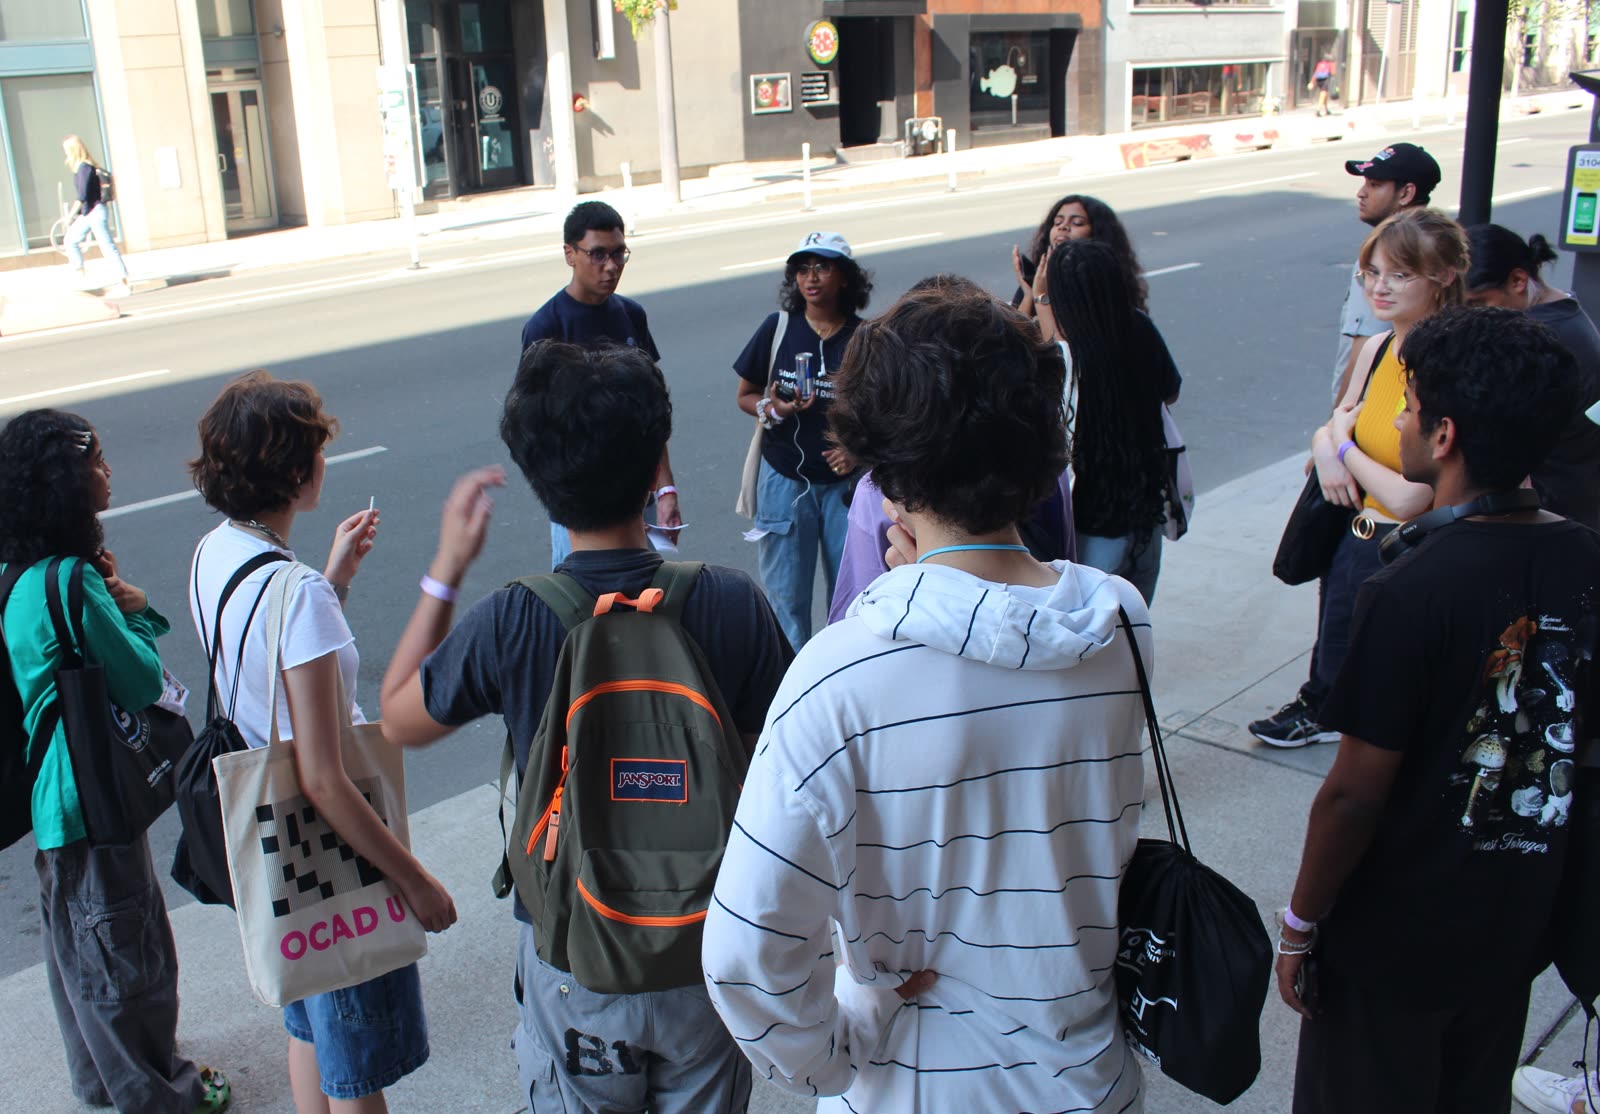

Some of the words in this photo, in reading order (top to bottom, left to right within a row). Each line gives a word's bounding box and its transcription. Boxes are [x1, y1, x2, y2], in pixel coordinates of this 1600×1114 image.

[1402, 525, 1417, 535] SONY
[618, 772, 681, 789] JANSPORT
[1500, 832, 1548, 854] Forager
[280, 906, 379, 961] OCAD
[385, 895, 406, 922] U
